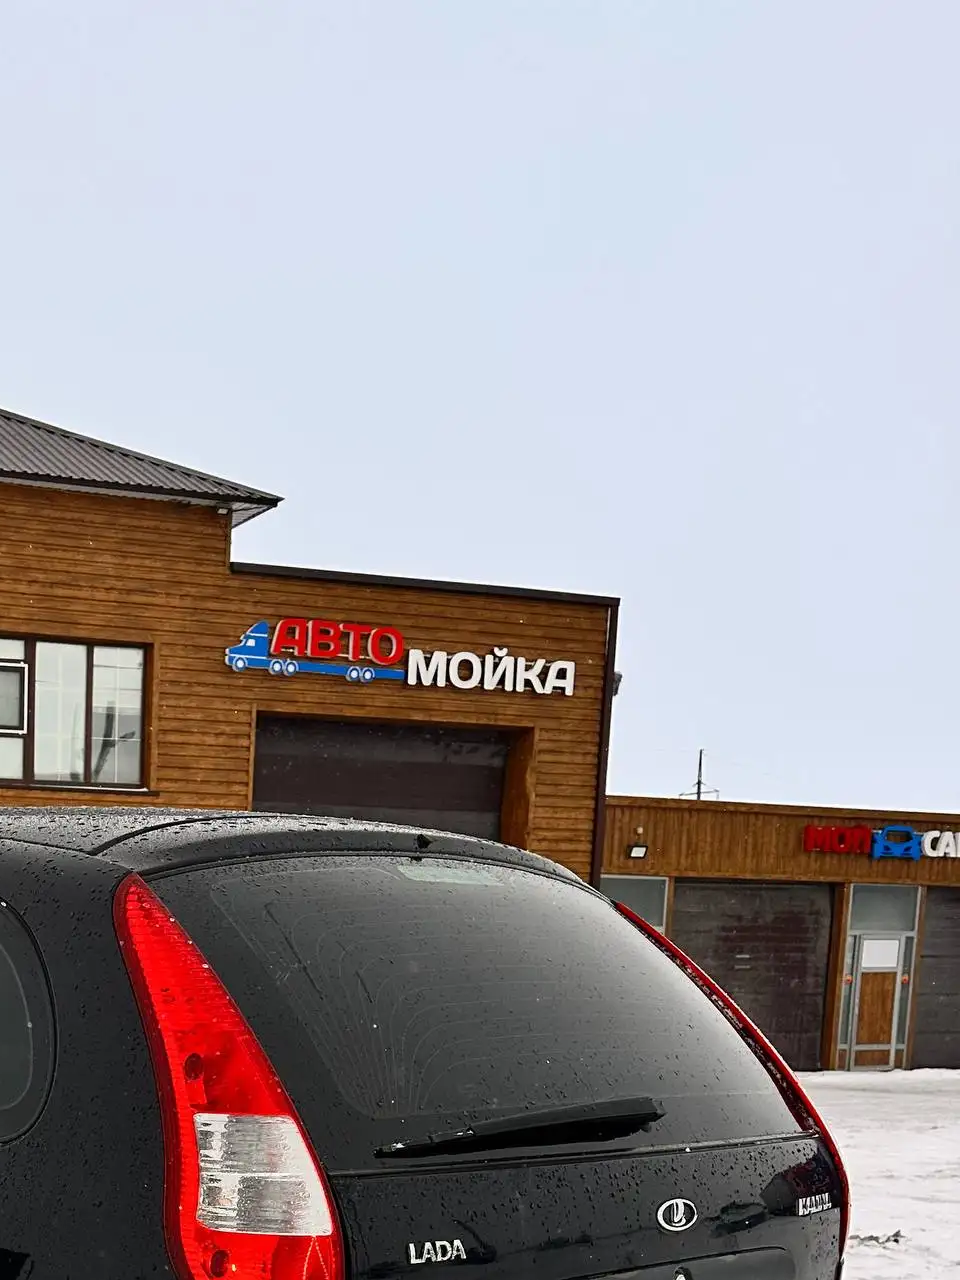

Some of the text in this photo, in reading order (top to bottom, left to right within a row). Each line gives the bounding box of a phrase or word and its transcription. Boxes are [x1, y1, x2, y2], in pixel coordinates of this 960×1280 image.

[270, 617, 577, 697] АВТО МОЙКА
[407, 1238, 468, 1265] LADA
